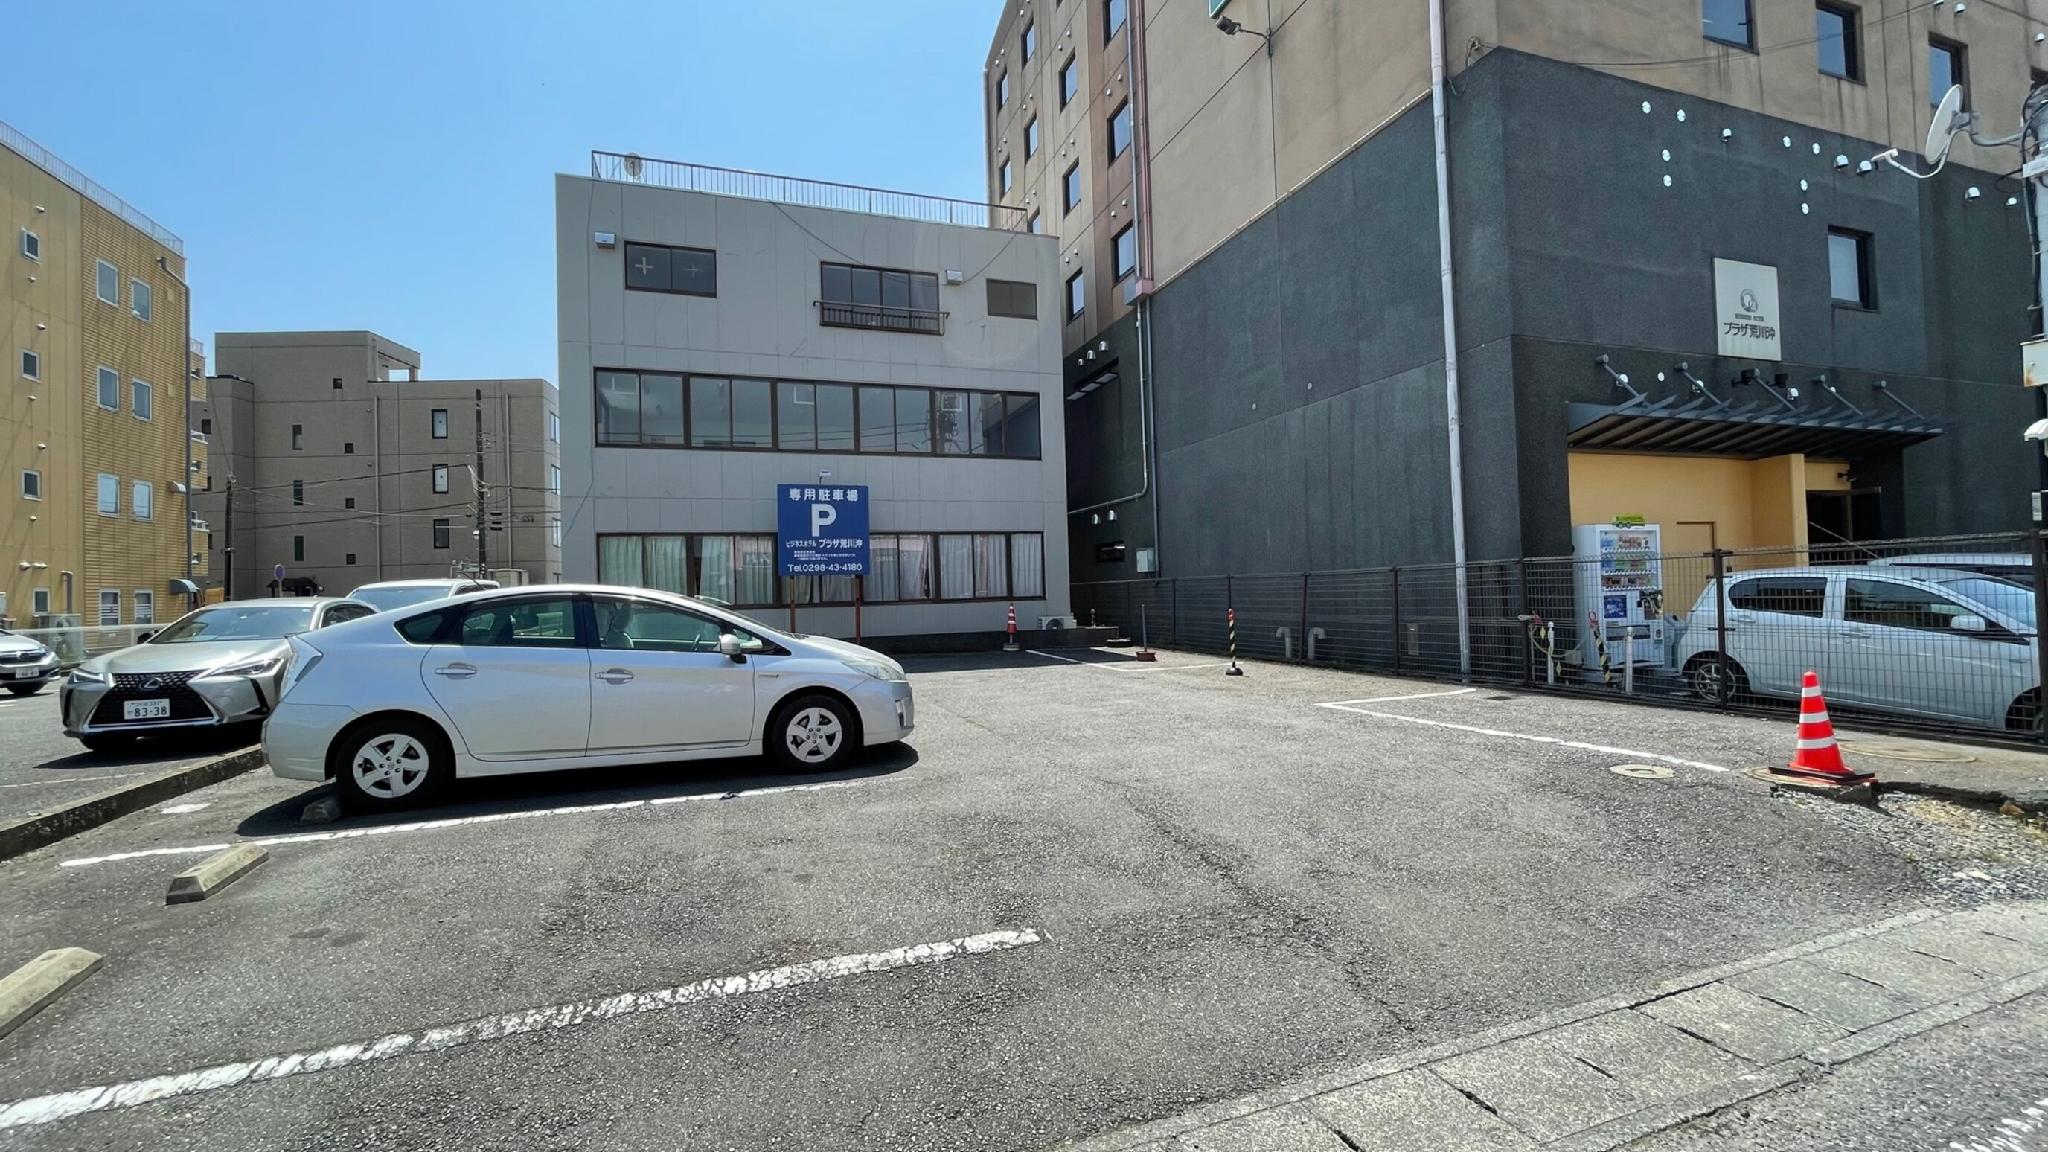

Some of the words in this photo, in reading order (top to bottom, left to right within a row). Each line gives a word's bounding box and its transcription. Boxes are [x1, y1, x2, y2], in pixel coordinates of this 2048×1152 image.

[1724, 322, 1776, 340] プラザ荒川沖
[789, 488, 859, 502] 専用駐車場
[812, 504, 837, 537] P
[134, 706, 167, 717] 83-38
